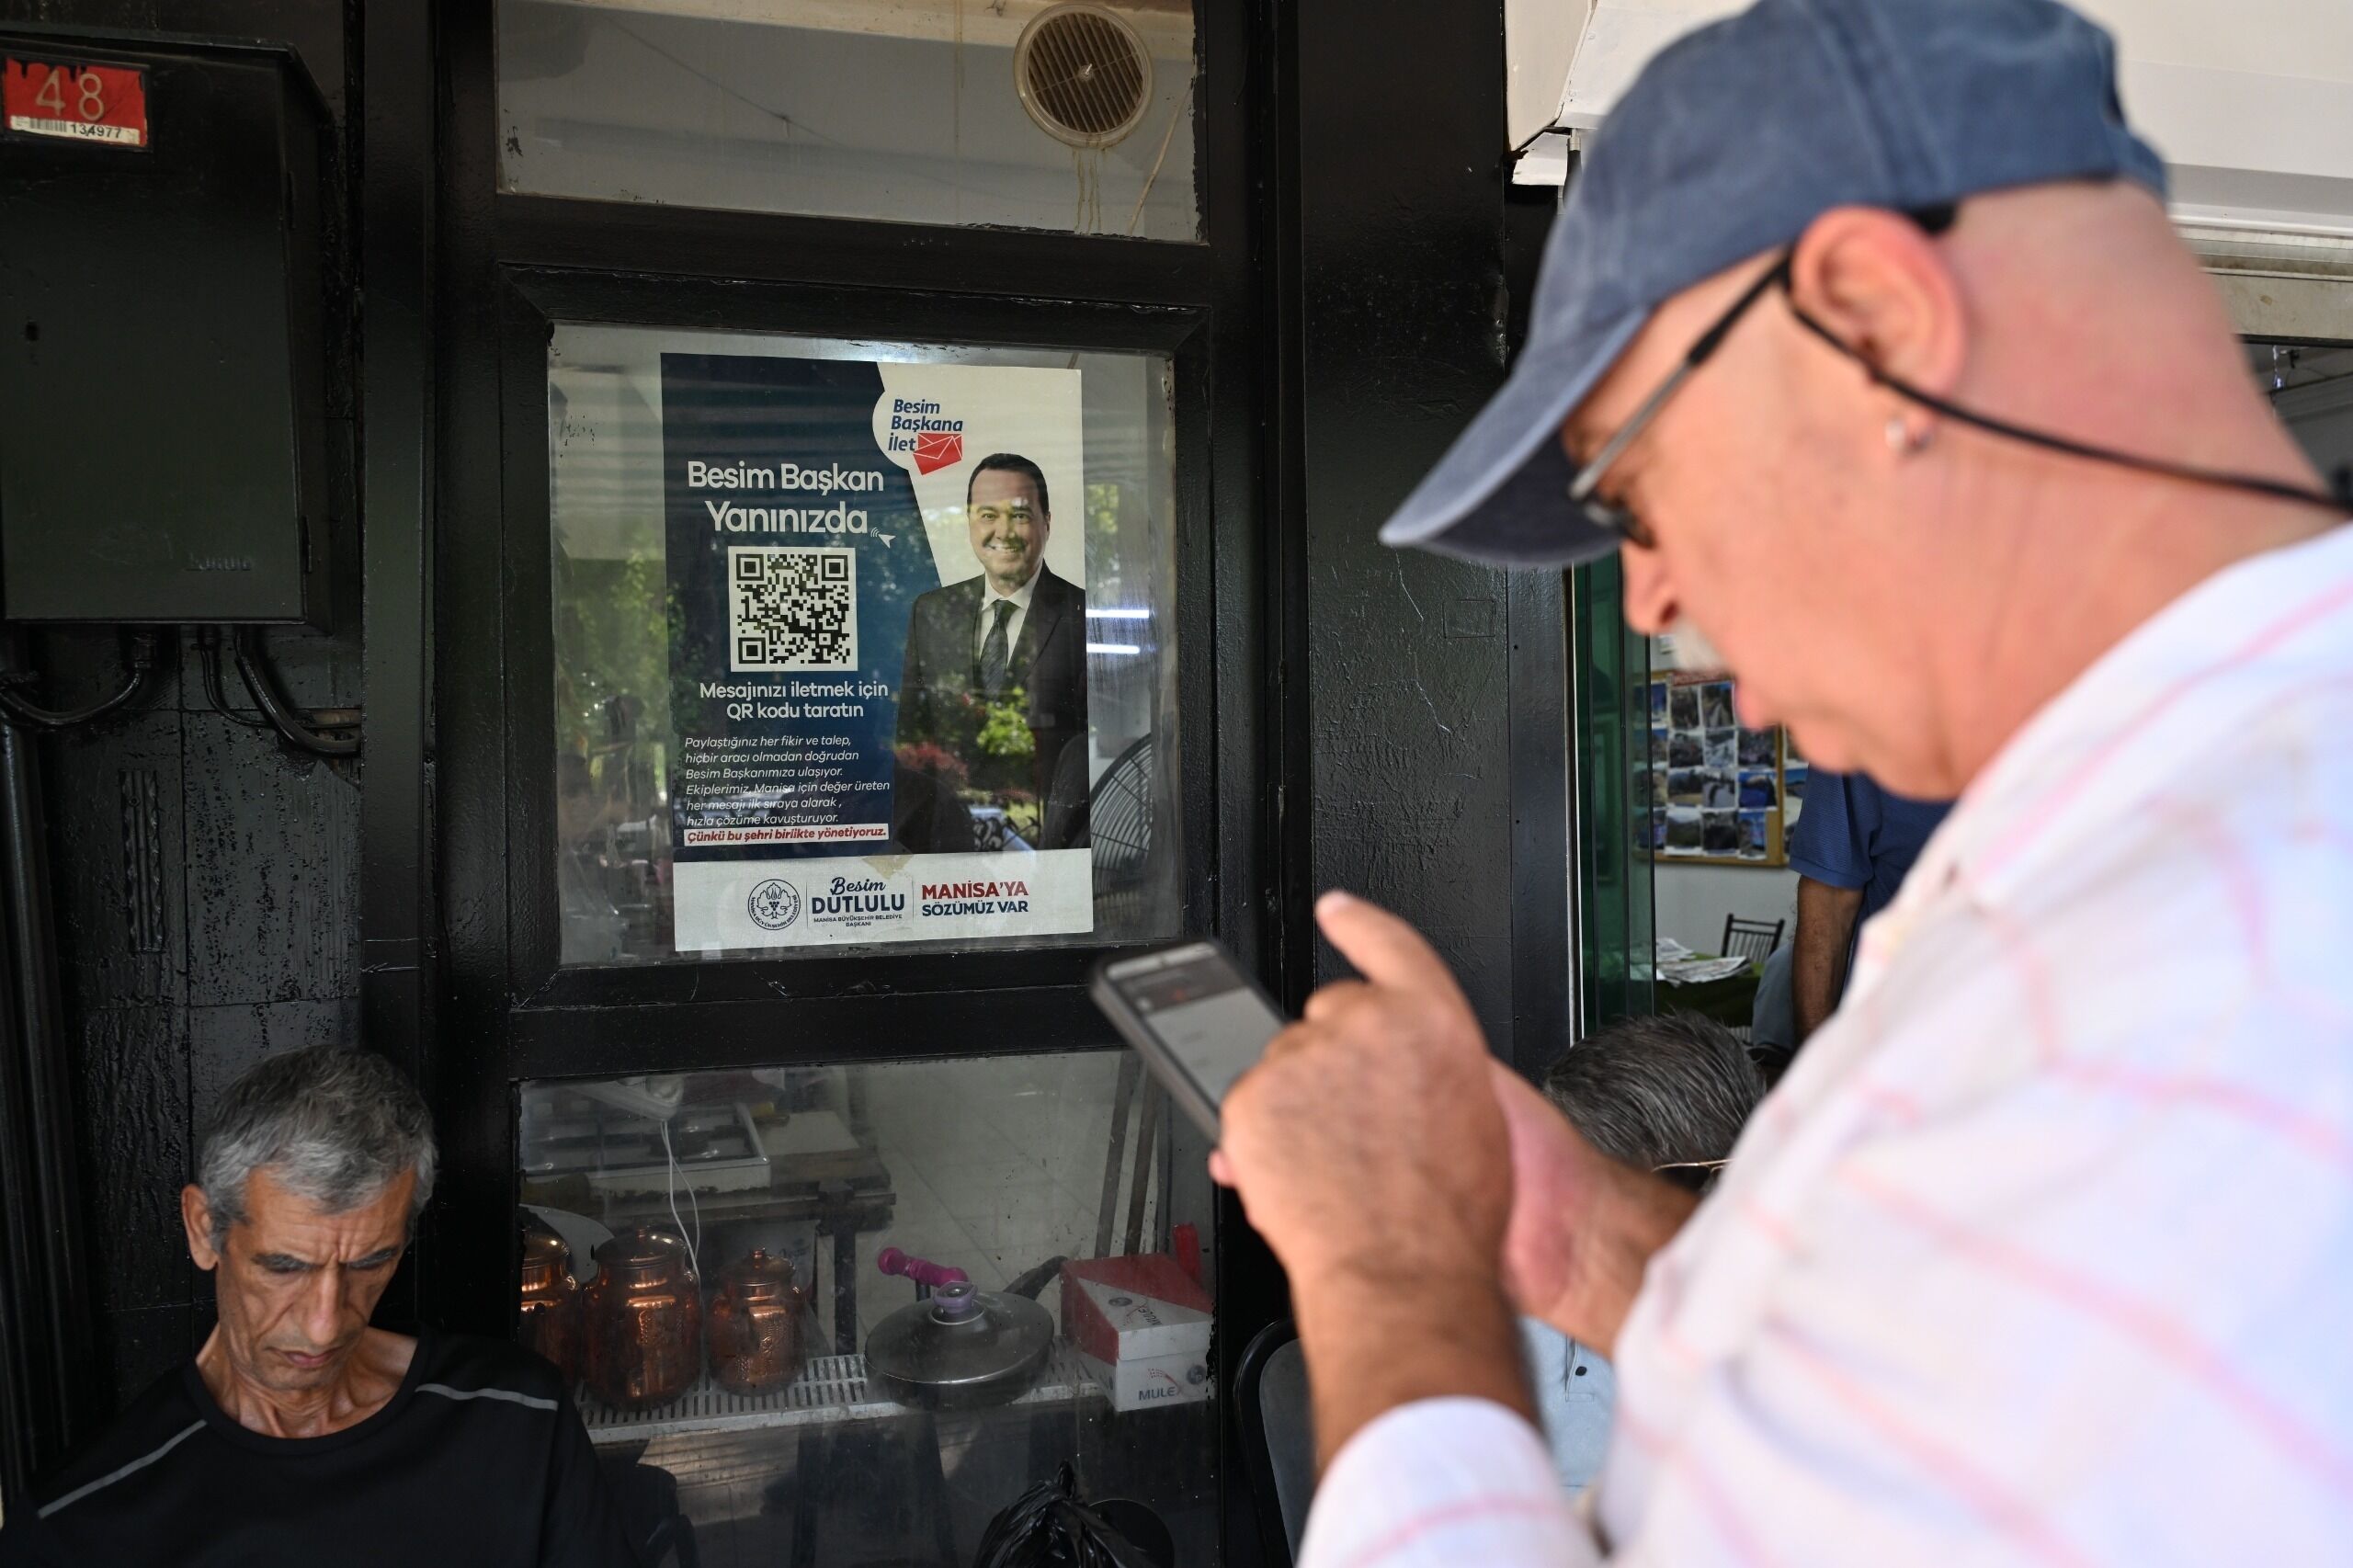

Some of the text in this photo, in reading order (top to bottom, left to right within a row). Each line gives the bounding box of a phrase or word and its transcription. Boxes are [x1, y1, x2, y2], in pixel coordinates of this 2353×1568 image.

[893, 399, 940, 414] Besim
[892, 415, 963, 432] Başkana
[688, 460, 884, 496] Besim Başkan
[704, 500, 868, 533] Yanınızda
[699, 680, 889, 701] Mesajınızı iletmek için
[726, 702, 863, 722] QR kodu taratın
[685, 737, 757, 749] Paylaştığınız
[760, 736, 779, 746] her
[781, 735, 804, 746] fikir
[821, 735, 851, 747] talep,
[685, 750, 859, 765] hiçbir aracı olmadan doğrudan
[686, 766, 843, 780] Besim Başkanımıza ulaşıyor.
[686, 780, 890, 796] Ekiplerimiz, Manisa için değer üreten
[687, 800, 704, 811] her
[708, 800, 746, 812] mesajı
[748, 799, 761, 809] ilk
[764, 800, 798, 812] sıraya
[801, 797, 837, 808] alarak
[687, 812, 839, 828] hızla çözüme kavuşturuyor.
[688, 827, 887, 844] Çünkü bu şehri birlikte yönetiyoruz.
[830, 876, 886, 895] Besim
[921, 881, 1029, 900] MANİSA'YA
[812, 894, 905, 915] DUTLULU
[921, 900, 1029, 917] SÖZÜMÜZ VAR
